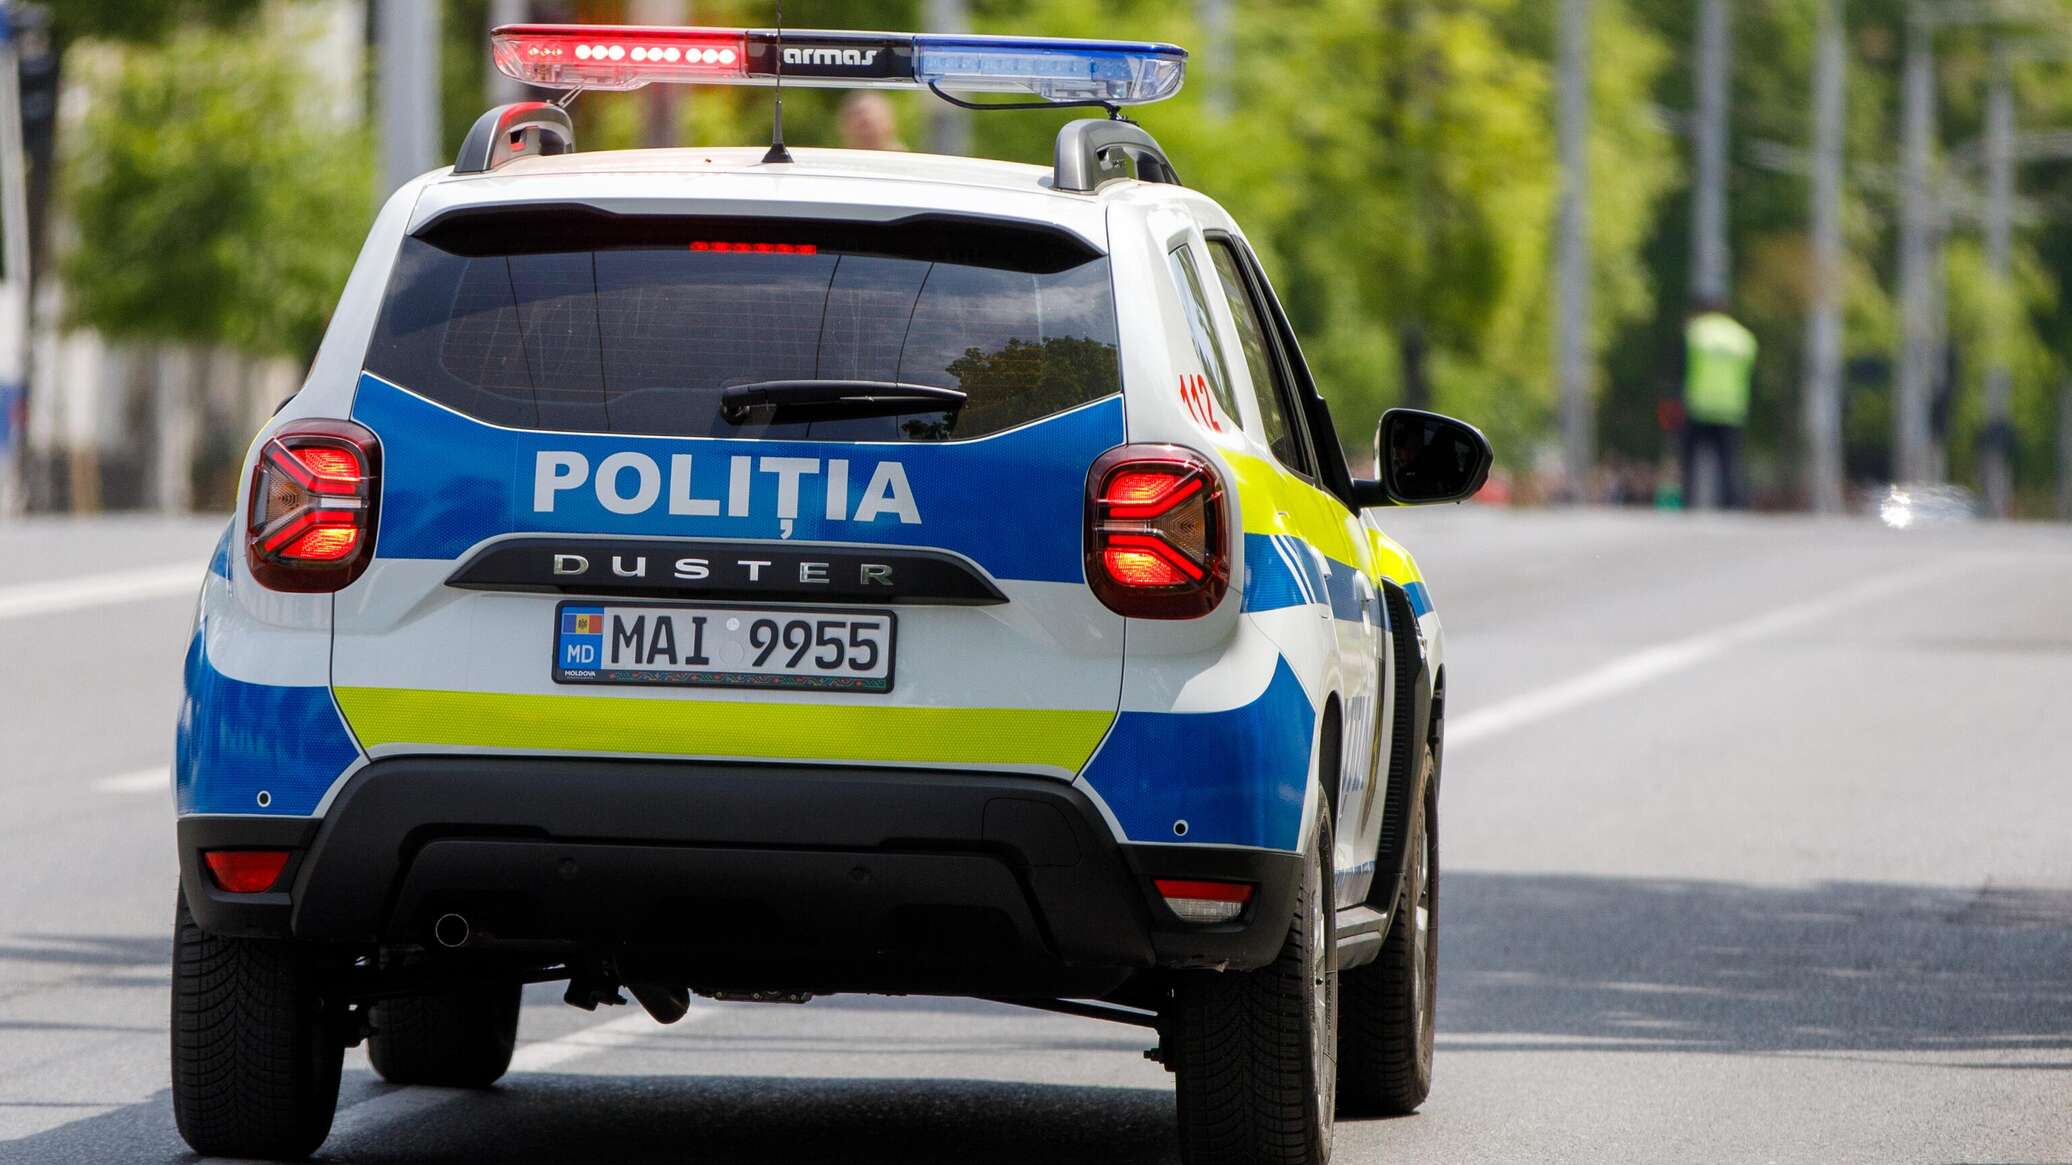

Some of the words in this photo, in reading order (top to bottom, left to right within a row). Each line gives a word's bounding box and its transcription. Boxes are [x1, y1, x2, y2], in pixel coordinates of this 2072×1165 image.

[783, 48, 877, 65] armas
[1179, 374, 1222, 433] 112
[533, 451, 922, 539] POLIȚIA
[553, 554, 894, 586] DUSTER
[567, 644, 595, 664] MD
[611, 615, 710, 666] MAI
[750, 618, 880, 671] 9955
